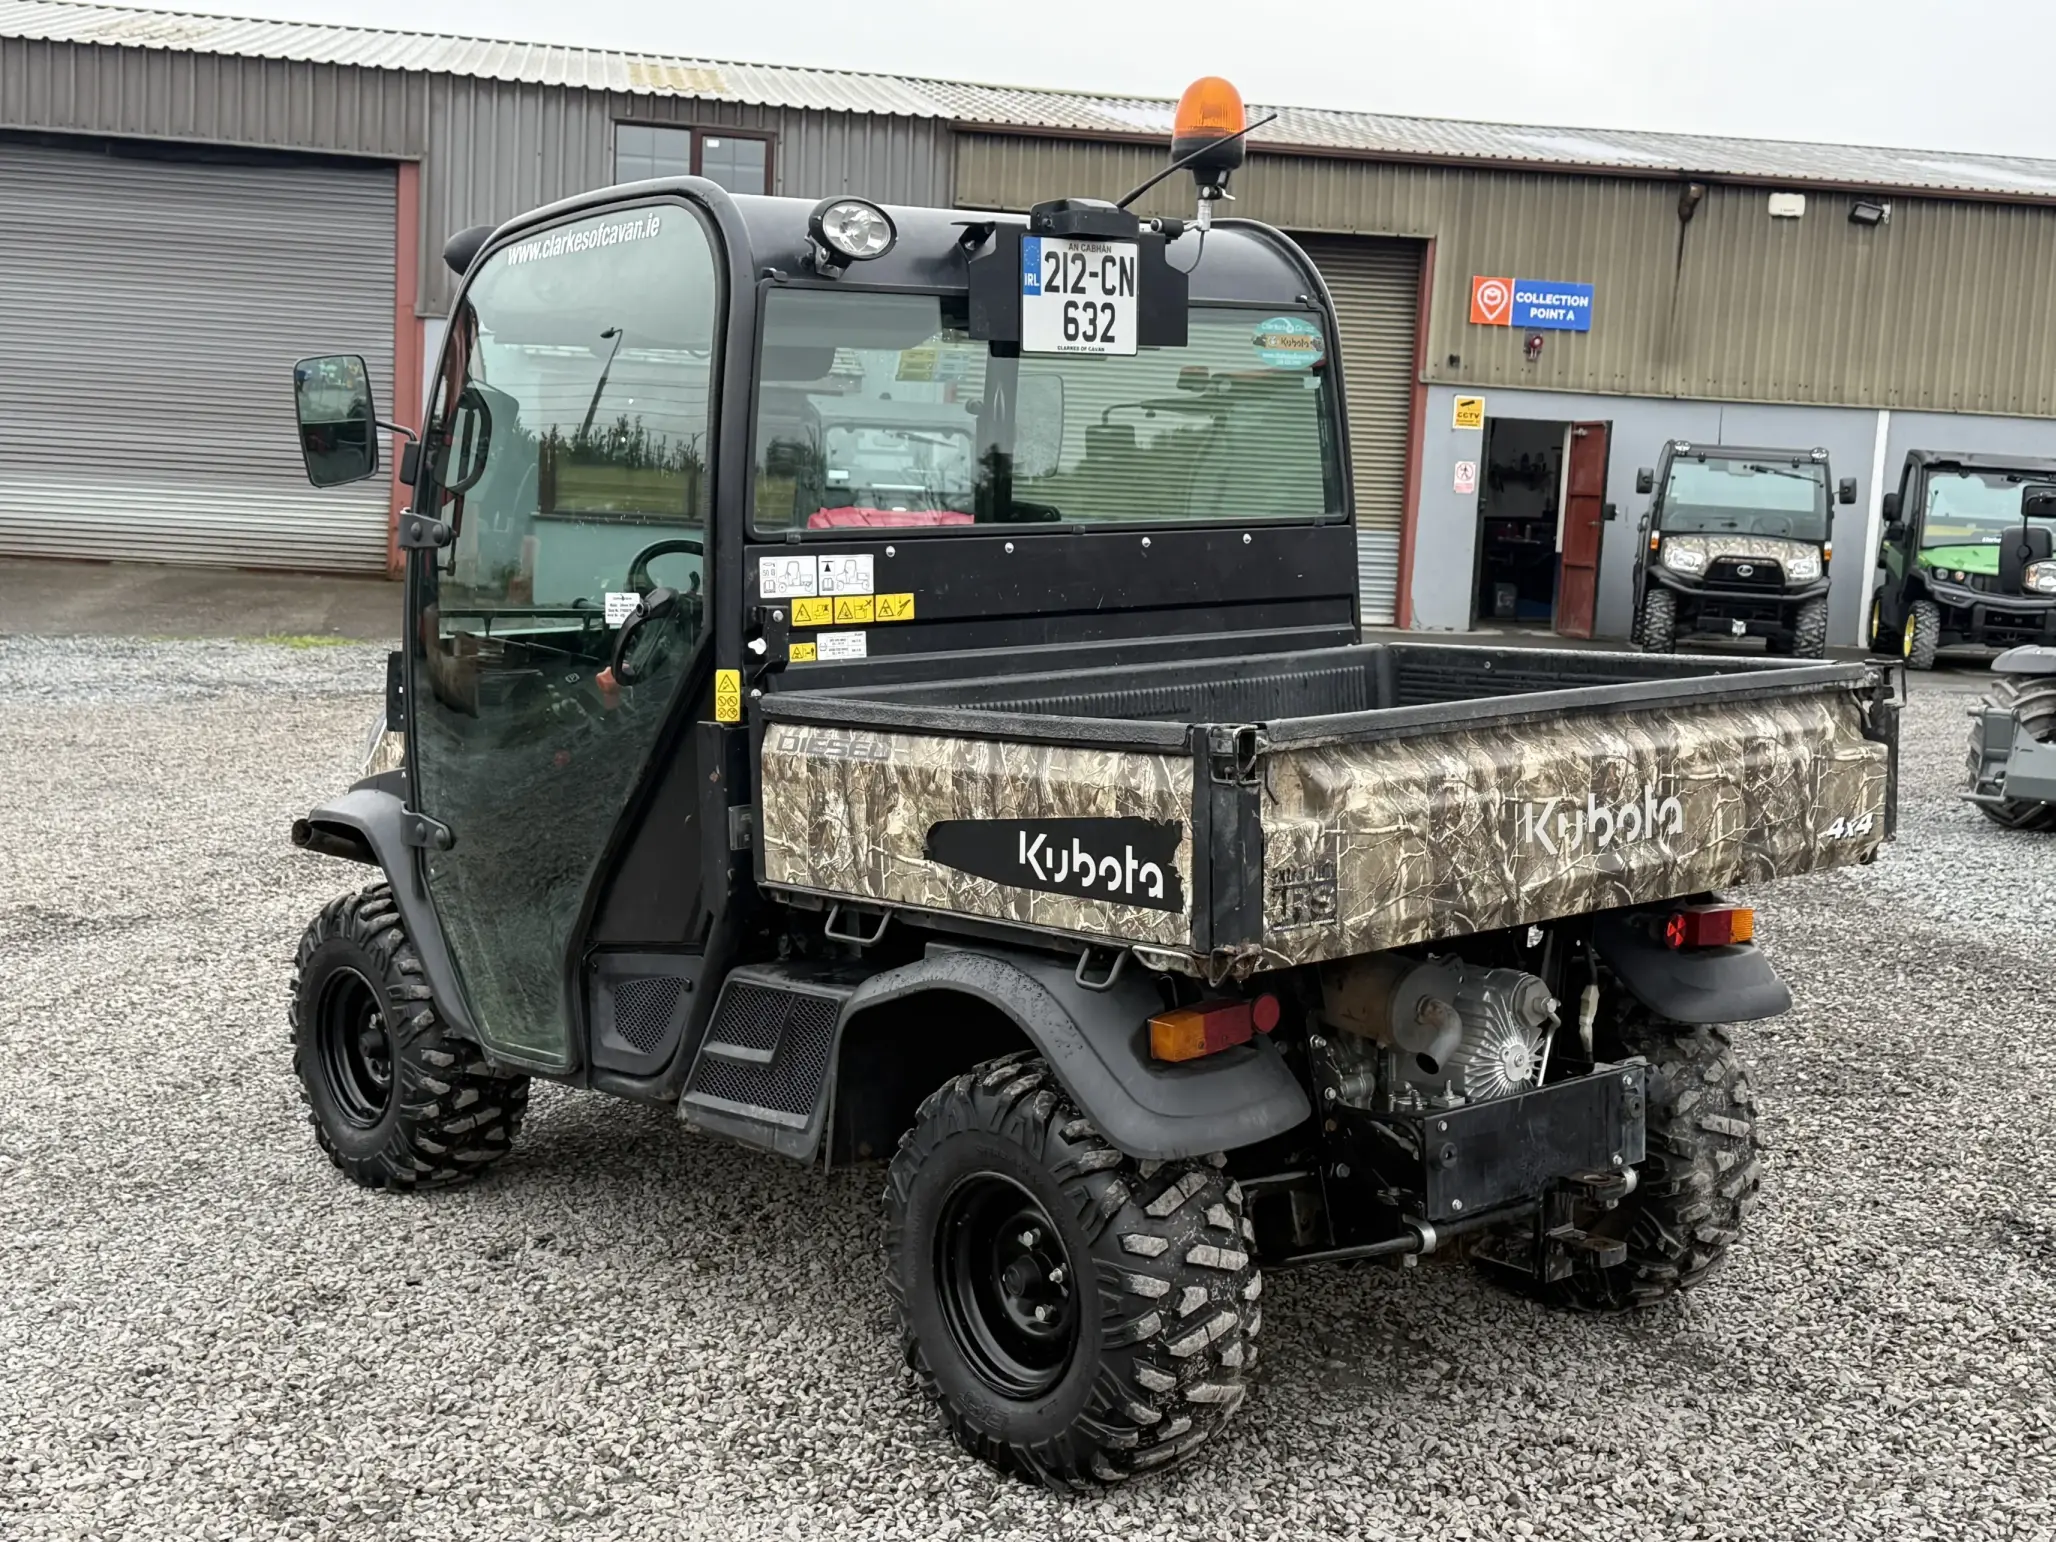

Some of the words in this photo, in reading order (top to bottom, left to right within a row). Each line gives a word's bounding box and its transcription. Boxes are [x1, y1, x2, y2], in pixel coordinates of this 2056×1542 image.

[508, 213, 660, 265] www.clarkesofcavan.ie
[1068, 243, 1079, 251] AN
[1024, 273, 1040, 286] IRL
[1044, 251, 1134, 297] 212-CN
[1515, 292, 1589, 307] COLLECTION
[1063, 300, 1116, 343] 632
[1529, 307, 1565, 320] POINT
[1566, 310, 1575, 321] A
[1280, 336, 1310, 348] Kubota
[777, 734, 890, 760] DIESEL
[1525, 784, 1683, 855] Kubota
[1827, 812, 1873, 839] 4x4
[1019, 830, 1163, 899] Kubota
